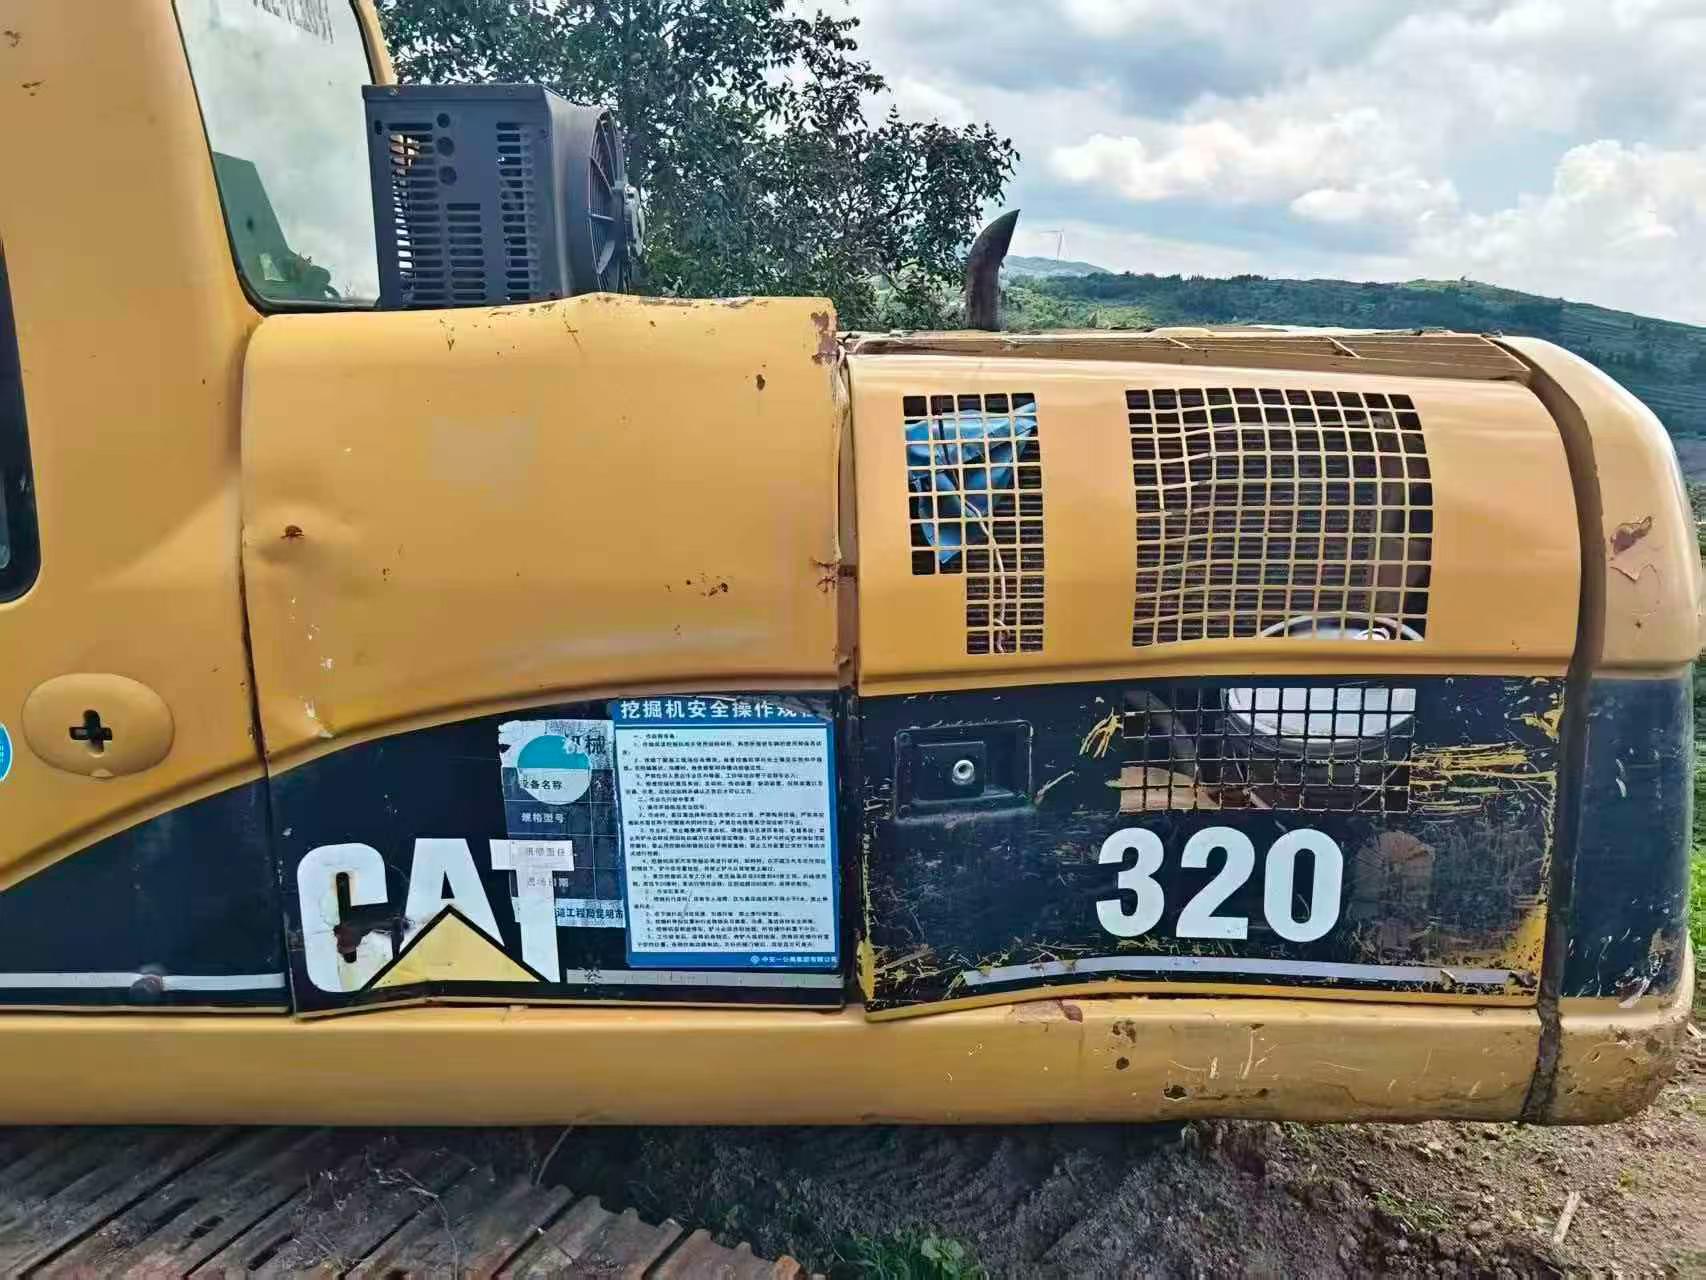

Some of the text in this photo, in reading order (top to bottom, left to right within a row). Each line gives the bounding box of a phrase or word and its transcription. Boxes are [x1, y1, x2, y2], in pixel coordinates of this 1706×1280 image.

[621, 700, 814, 719] 挖掘机安全操作规
[297, 838, 574, 992] CAT
[1096, 826, 1343, 943] 320
